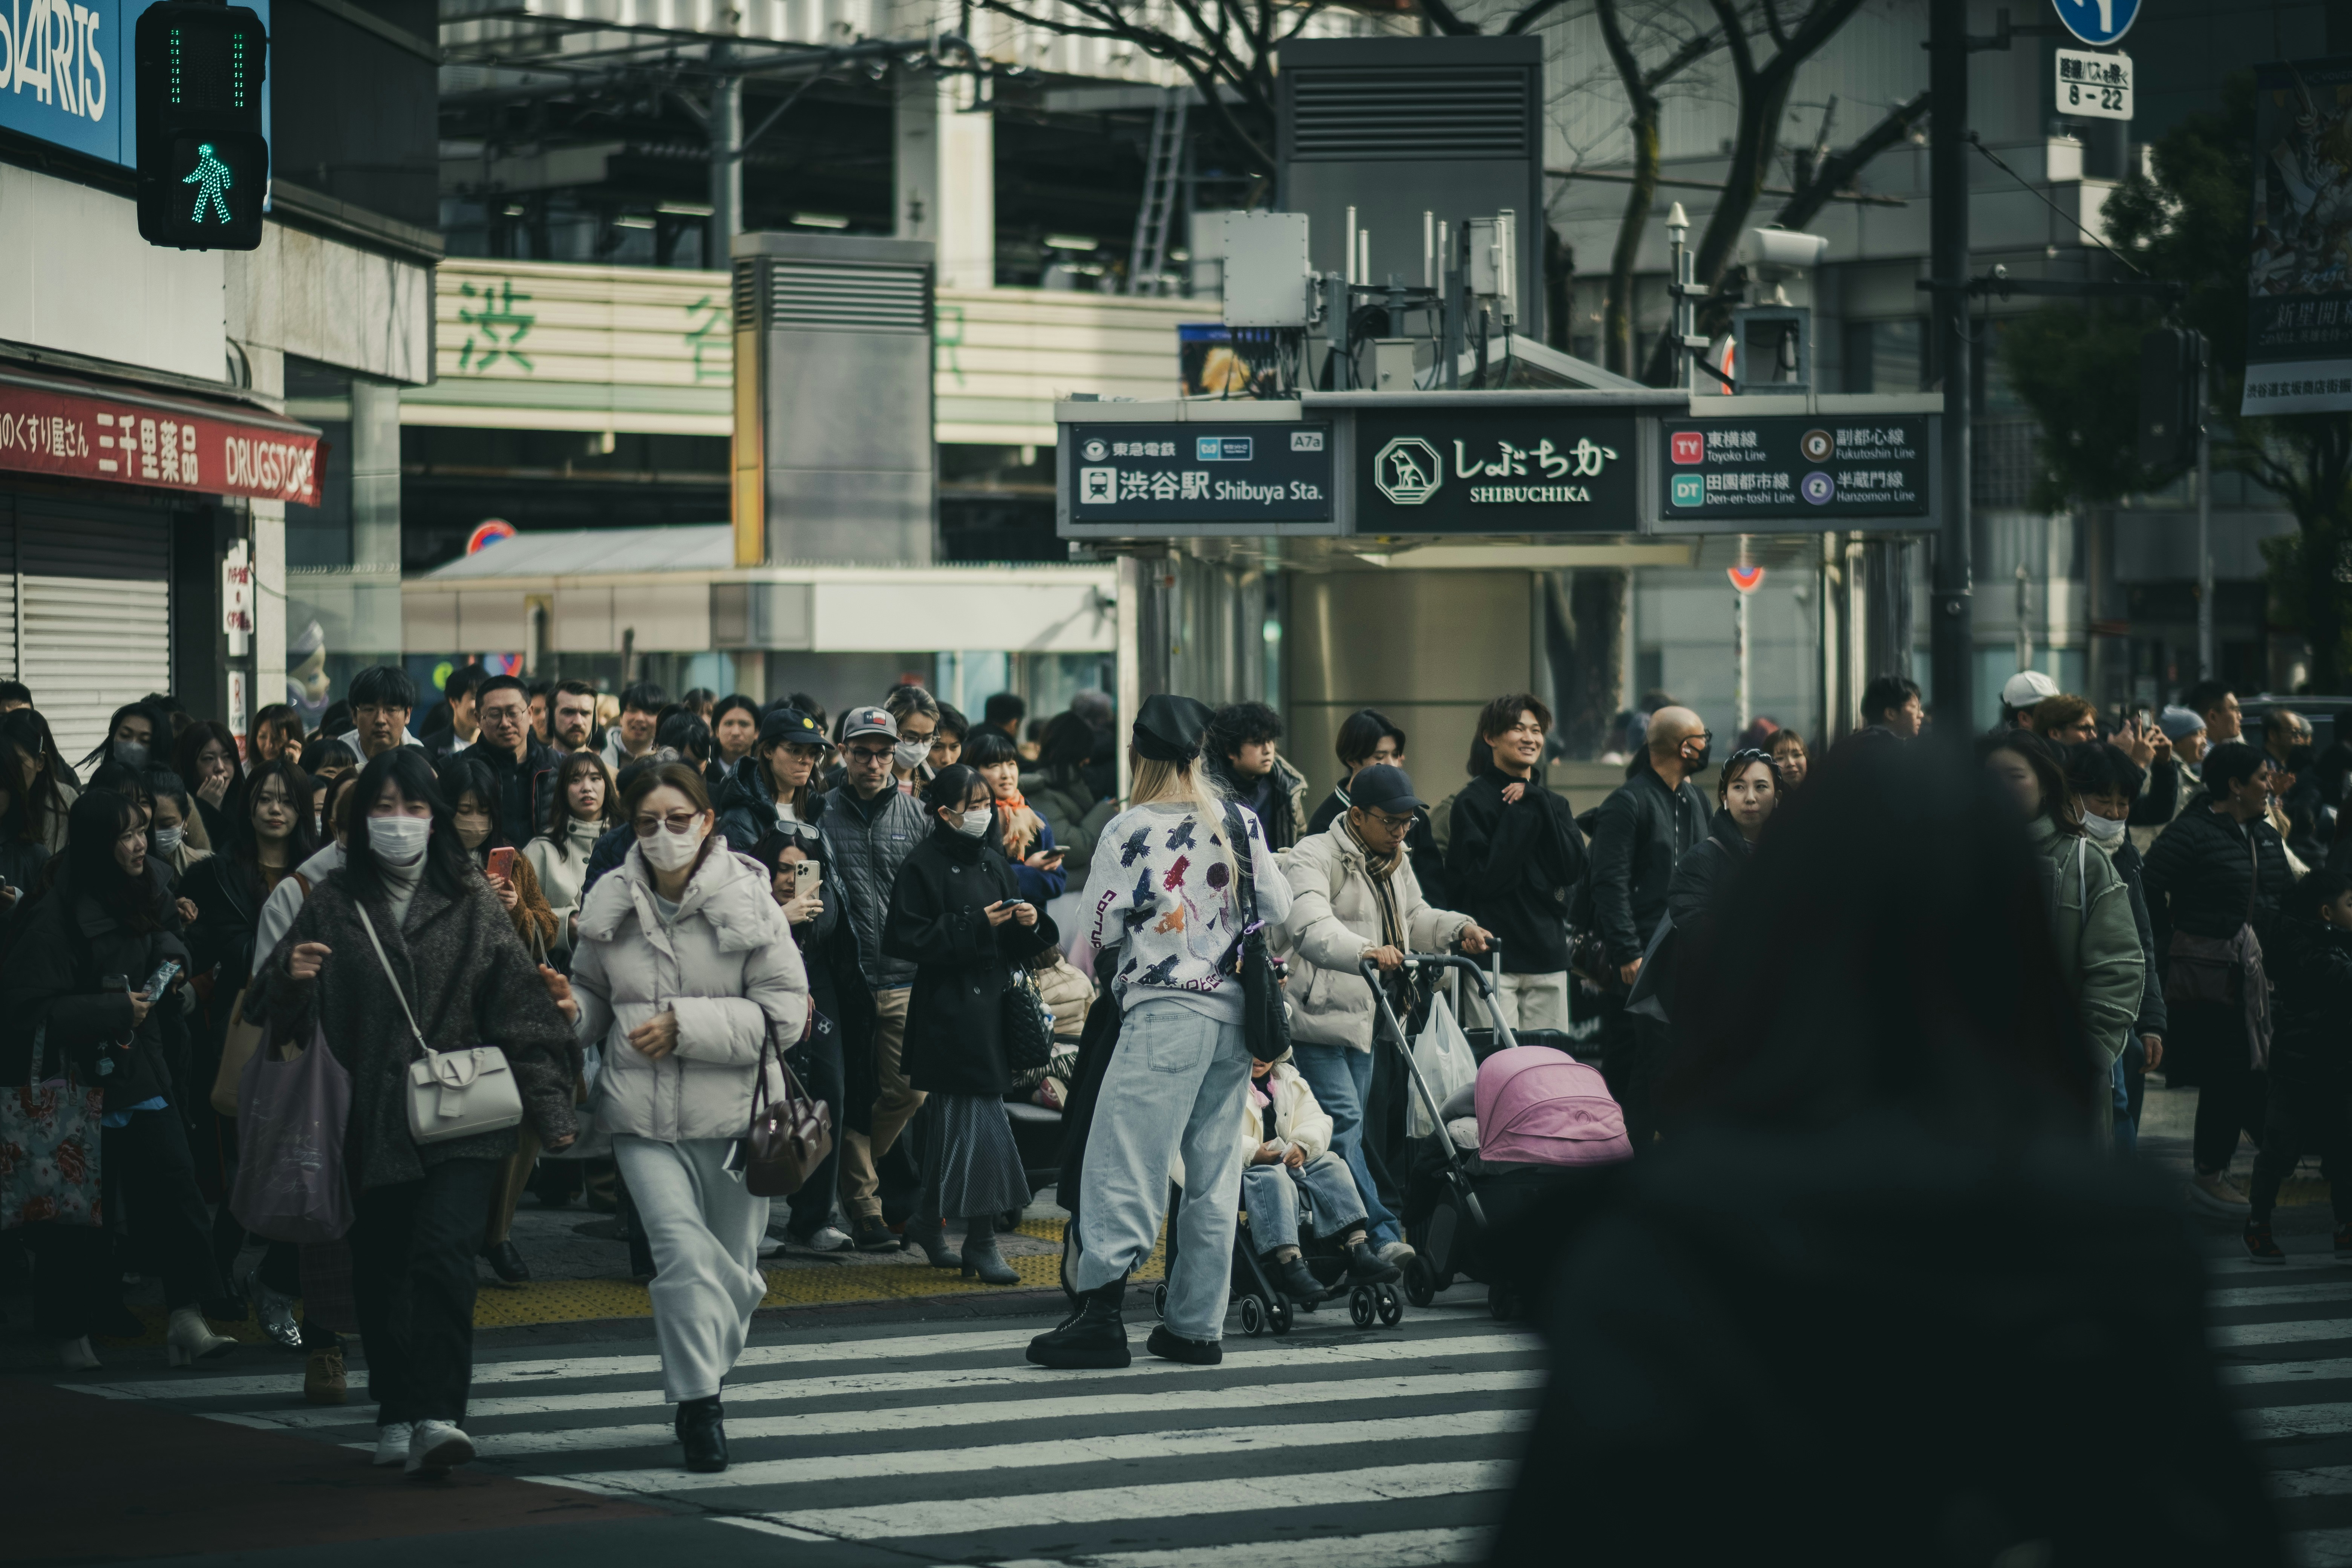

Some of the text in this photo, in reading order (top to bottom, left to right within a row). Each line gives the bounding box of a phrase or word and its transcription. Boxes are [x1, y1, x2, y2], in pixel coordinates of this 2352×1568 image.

[1294, 435, 1321, 448] A7a
[1706, 430, 1757, 448] 東横線
[1836, 428, 1905, 446] 副都心線
[0, 412, 314, 495] のくすり屋さん 三千里薬品 DRUGSTORE
[1113, 442, 1176, 457] 東急電鉄
[1677, 440, 1698, 455] TY
[1836, 447, 1916, 459] Fukutoshin Line
[1453, 437, 1618, 479] しぶちか
[1707, 449, 1766, 464] Toyoko Line
[1706, 472, 1789, 491] 田園都市線
[1837, 470, 1903, 489] 半蔵門線
[1119, 471, 1324, 505] 渋谷駅 Shibuya Sta.
[1470, 486, 1590, 502] SHIBUCHIKA
[1677, 483, 1698, 498] DT
[1707, 491, 1795, 504] Den-en-toshi Line
[1837, 490, 1915, 502] Hanzomon Line
